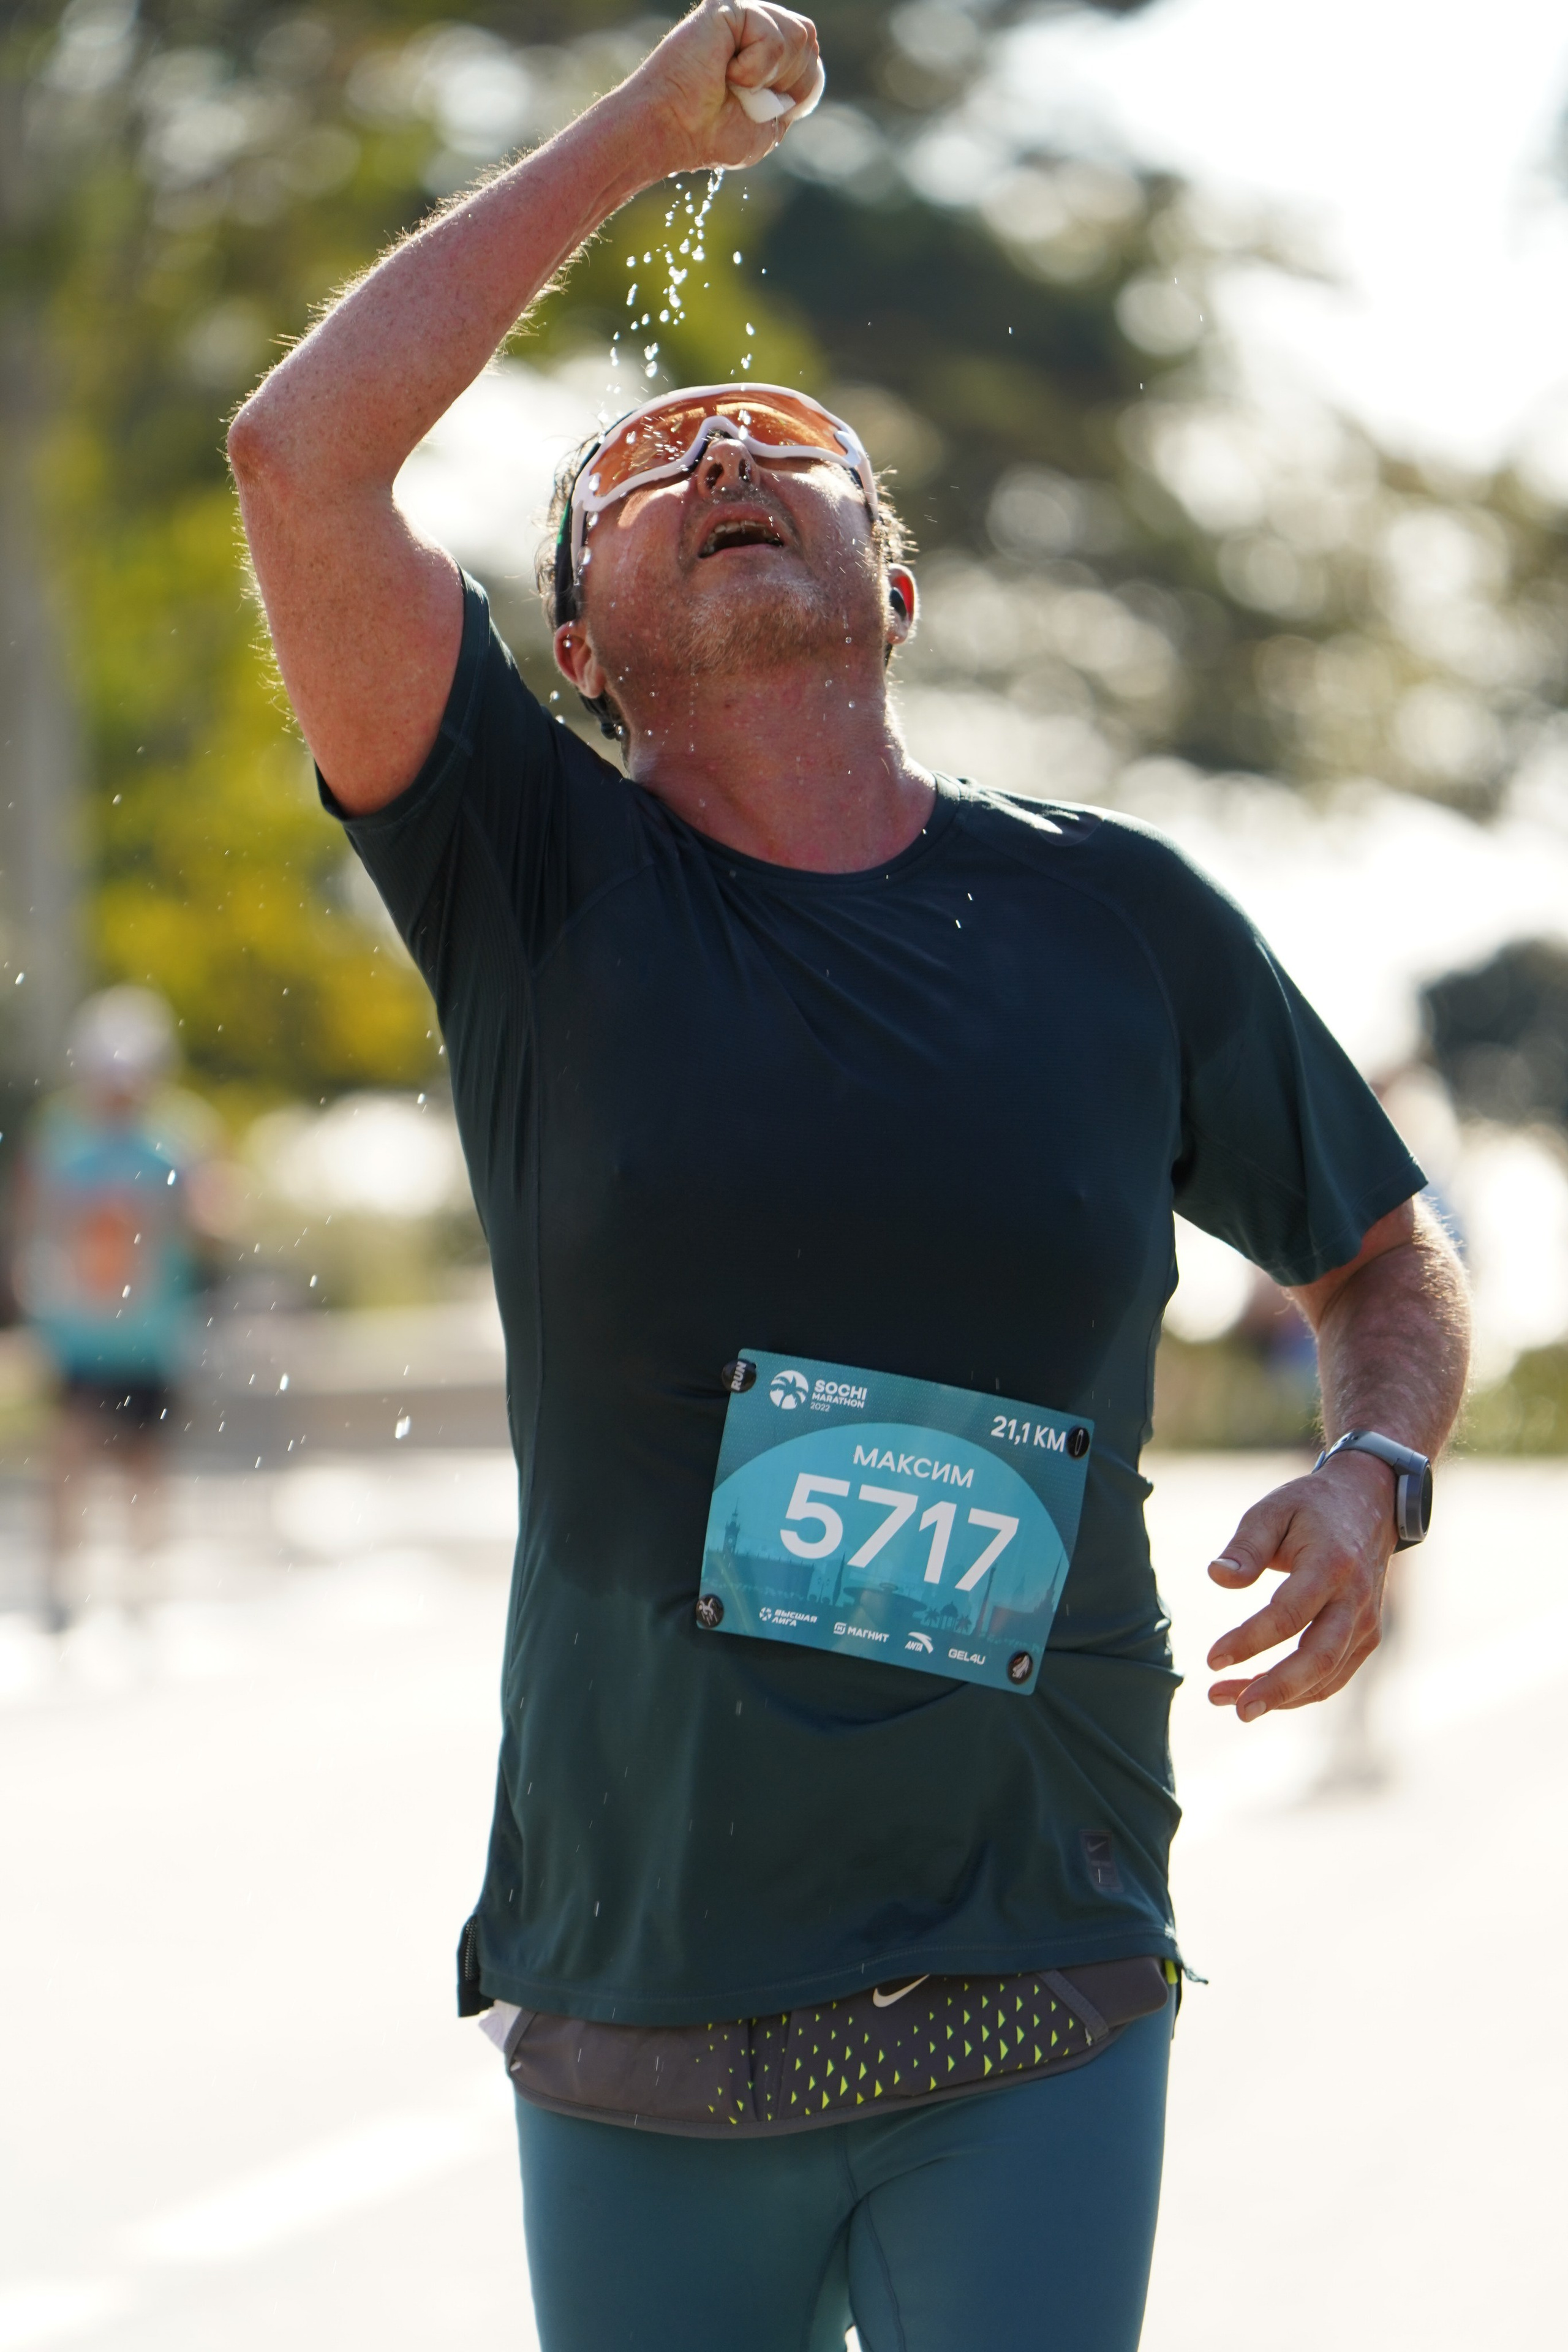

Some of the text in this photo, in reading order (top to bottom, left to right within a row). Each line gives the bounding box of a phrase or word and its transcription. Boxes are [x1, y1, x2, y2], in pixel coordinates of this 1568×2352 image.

[731, 1360, 747, 1391] RUN
[814, 1379, 867, 1400] SOCHI
[810, 1402, 831, 1412] 2022
[812, 1393, 865, 1409] MARATHON
[990, 1415, 1031, 1446] 21,1
[853, 1444, 974, 1488] МАКСИМ
[780, 1472, 1020, 1593] 5717
[771, 1616, 797, 1627] ЛИГА
[774, 1609, 818, 1623] ВЫСШАЯ
[847, 1626, 889, 1643] МАГНИТ
[905, 1640, 924, 1653] ANTA
[948, 1648, 986, 1665] GEL4U
